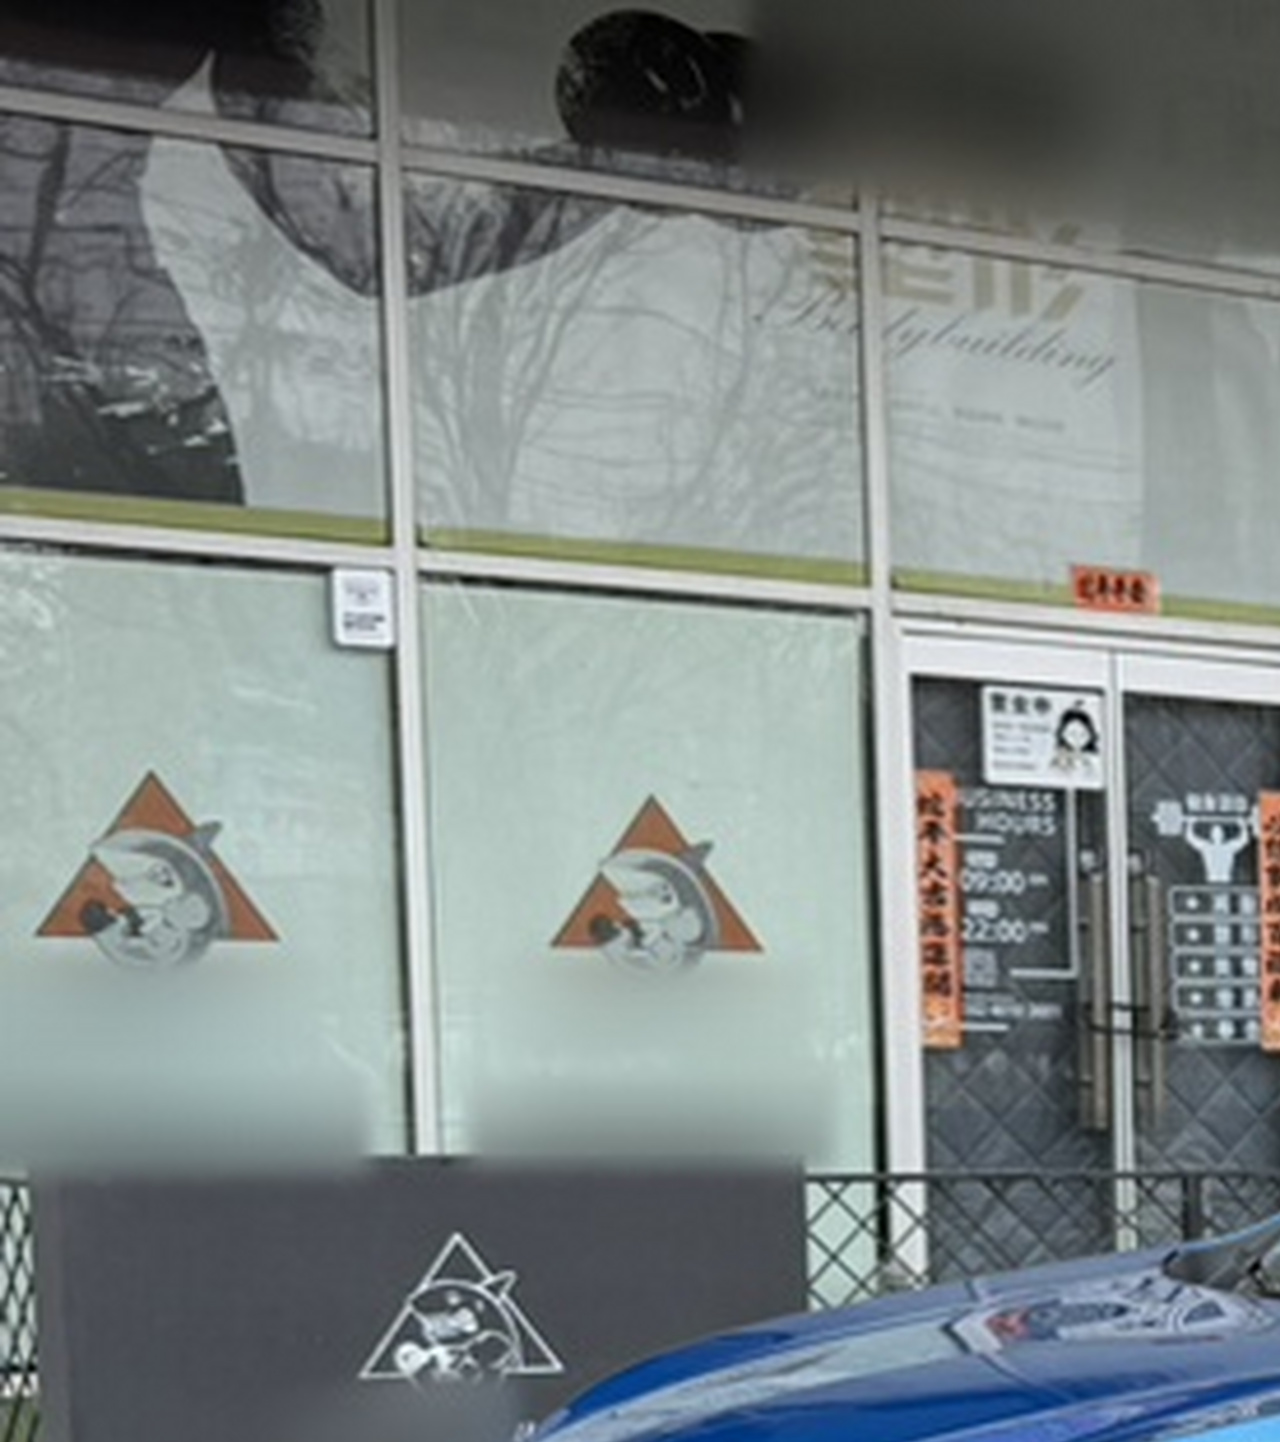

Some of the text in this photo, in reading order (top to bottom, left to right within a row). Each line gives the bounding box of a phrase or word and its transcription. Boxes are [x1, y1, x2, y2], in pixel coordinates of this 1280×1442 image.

[976, 810, 1057, 837] HOURS
[959, 867, 1027, 895] 09:00
[960, 913, 1028, 944] 22:00
